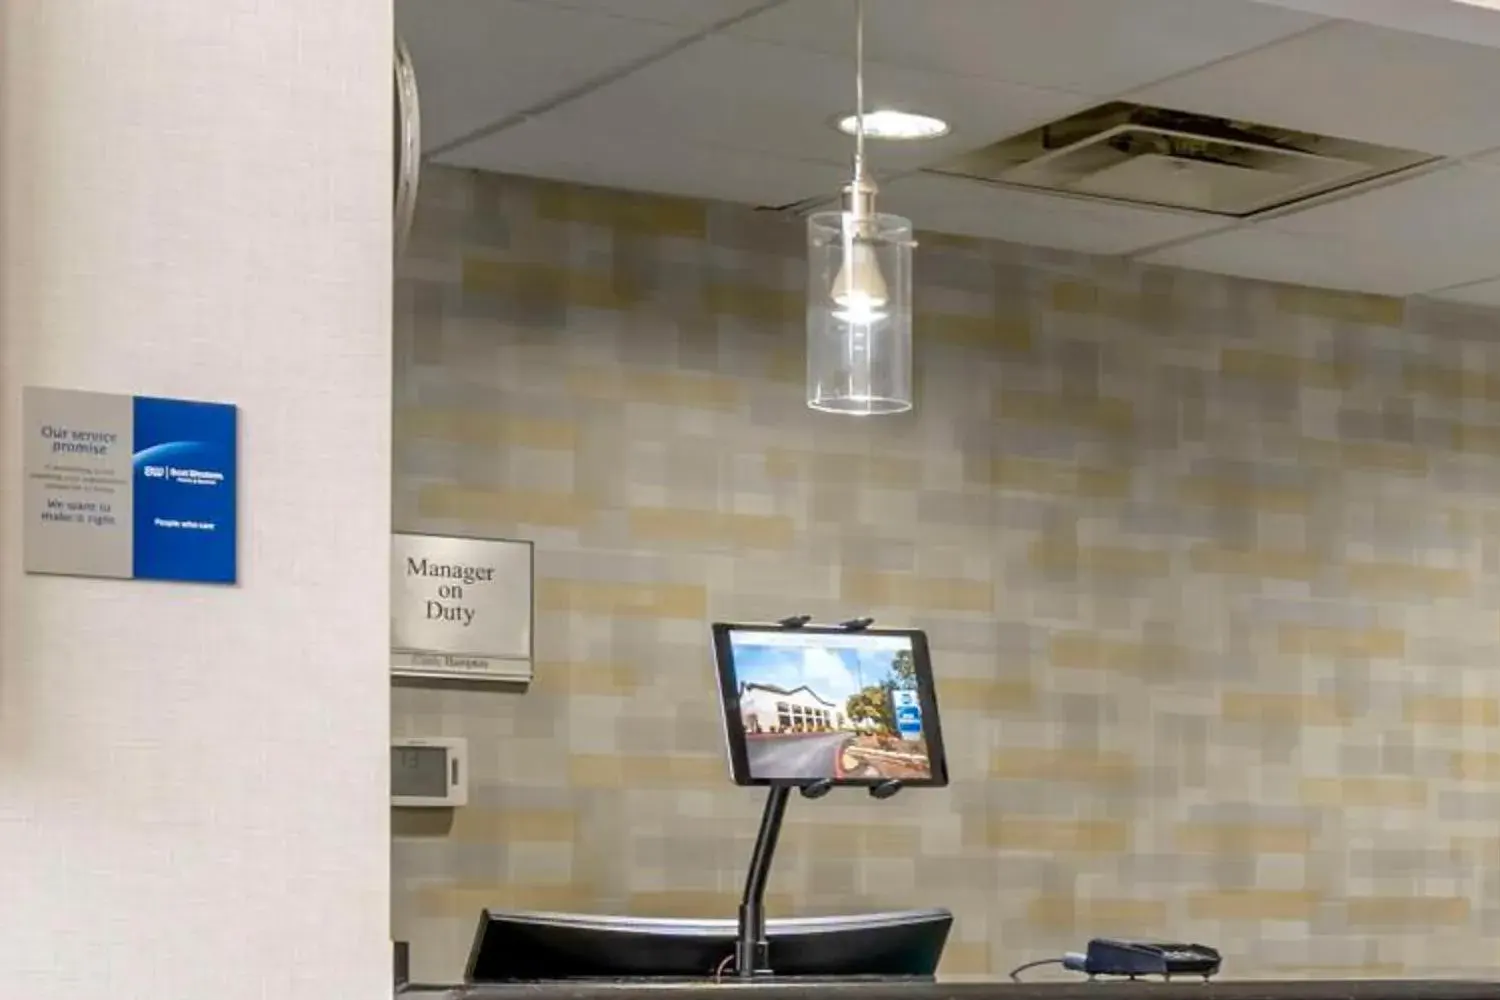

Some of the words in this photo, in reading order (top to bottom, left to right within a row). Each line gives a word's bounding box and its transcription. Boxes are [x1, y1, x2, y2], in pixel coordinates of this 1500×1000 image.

[41, 425, 67, 439] Our
[71, 430, 117, 444] service
[52, 440, 108, 456] promise
[406, 556, 496, 585] Manager
[438, 584, 463, 599] on
[426, 600, 475, 627] Duty
